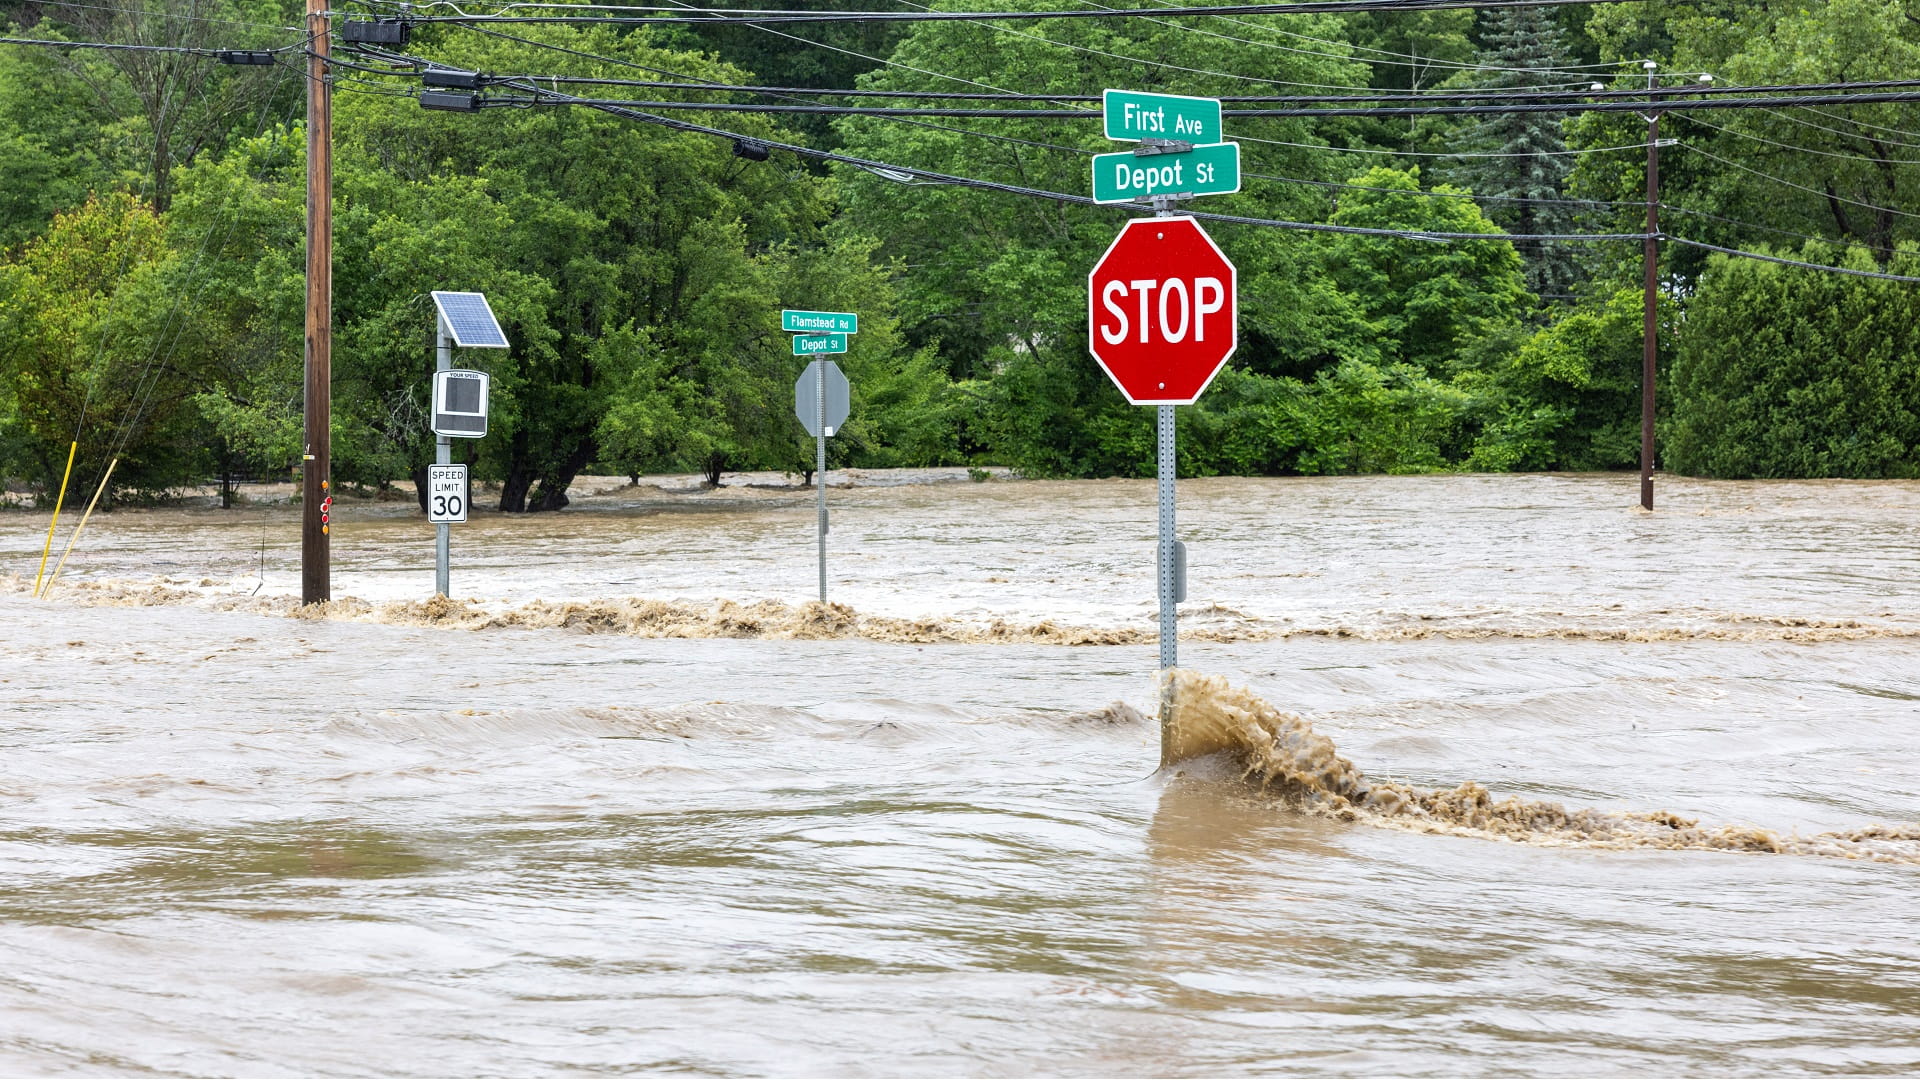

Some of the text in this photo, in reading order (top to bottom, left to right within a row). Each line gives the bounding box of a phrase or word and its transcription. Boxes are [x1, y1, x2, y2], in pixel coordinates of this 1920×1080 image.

[1124, 103, 1203, 135] First Ave
[1115, 159, 1215, 194] Depot St
[1100, 277, 1225, 345] STOP
[791, 315, 849, 329] Flamstead Rd
[801, 338, 838, 352] Depot St
[432, 471, 464, 480] SPEED
[435, 483, 460, 492] LIMIT
[433, 495, 462, 516] 30
